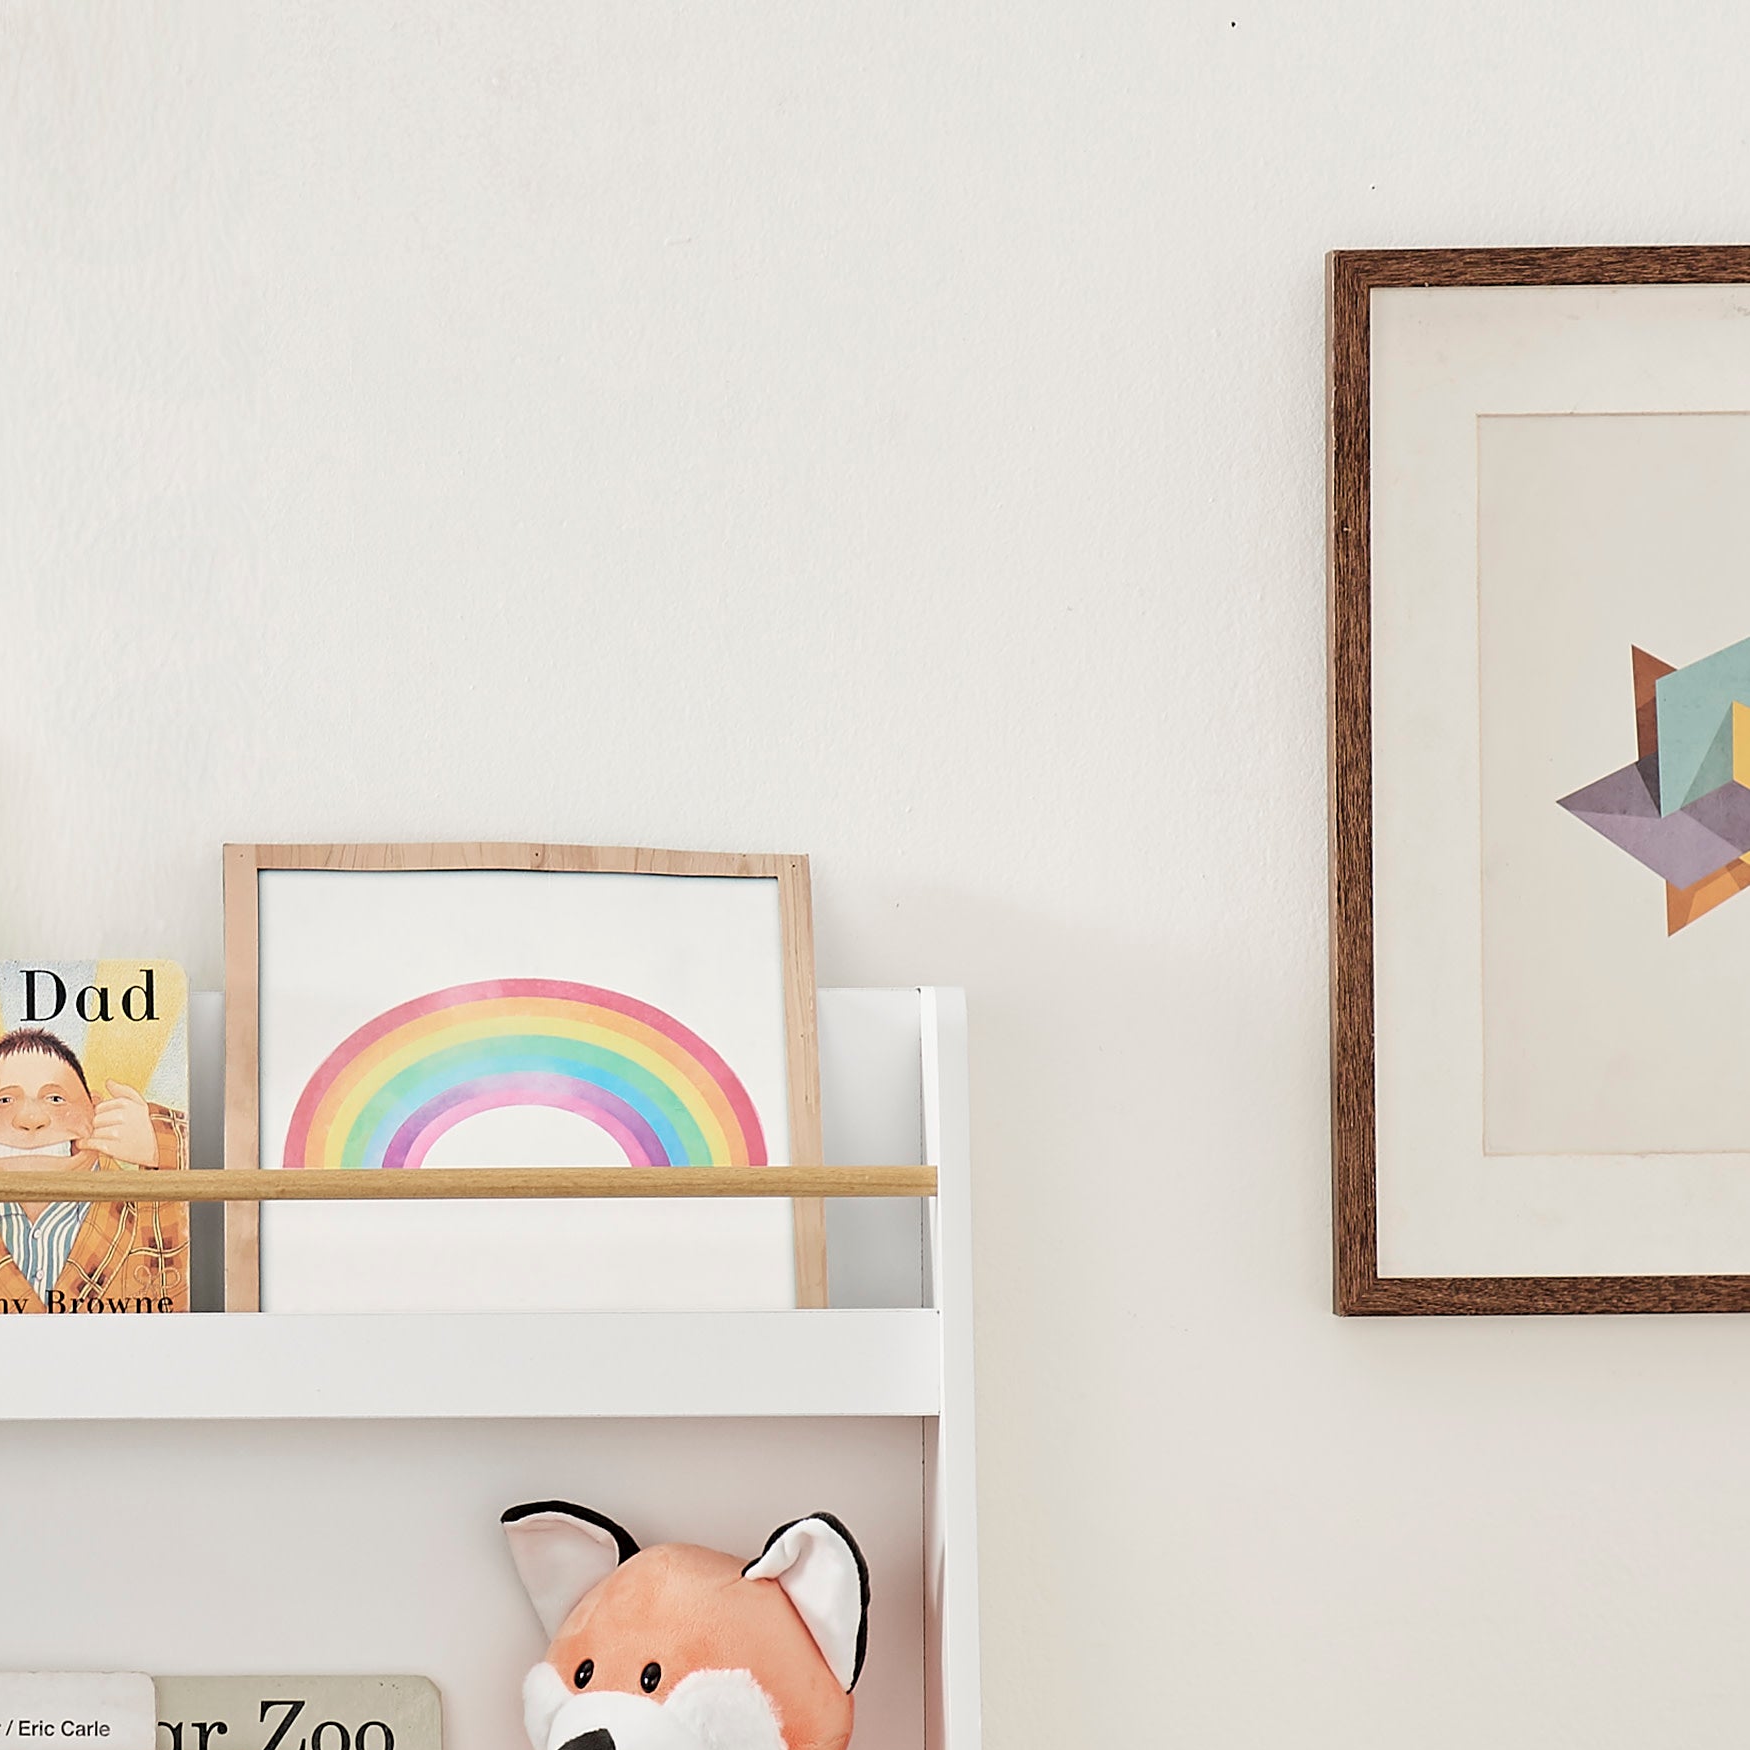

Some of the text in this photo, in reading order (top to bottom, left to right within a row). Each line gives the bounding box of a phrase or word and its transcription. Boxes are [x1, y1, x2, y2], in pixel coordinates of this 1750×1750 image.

[19, 969, 160, 1022] Dad
[45, 1289, 174, 1315] Browne
[18, 1720, 54, 1736] Eric
[61, 1720, 110, 1737] Carle
